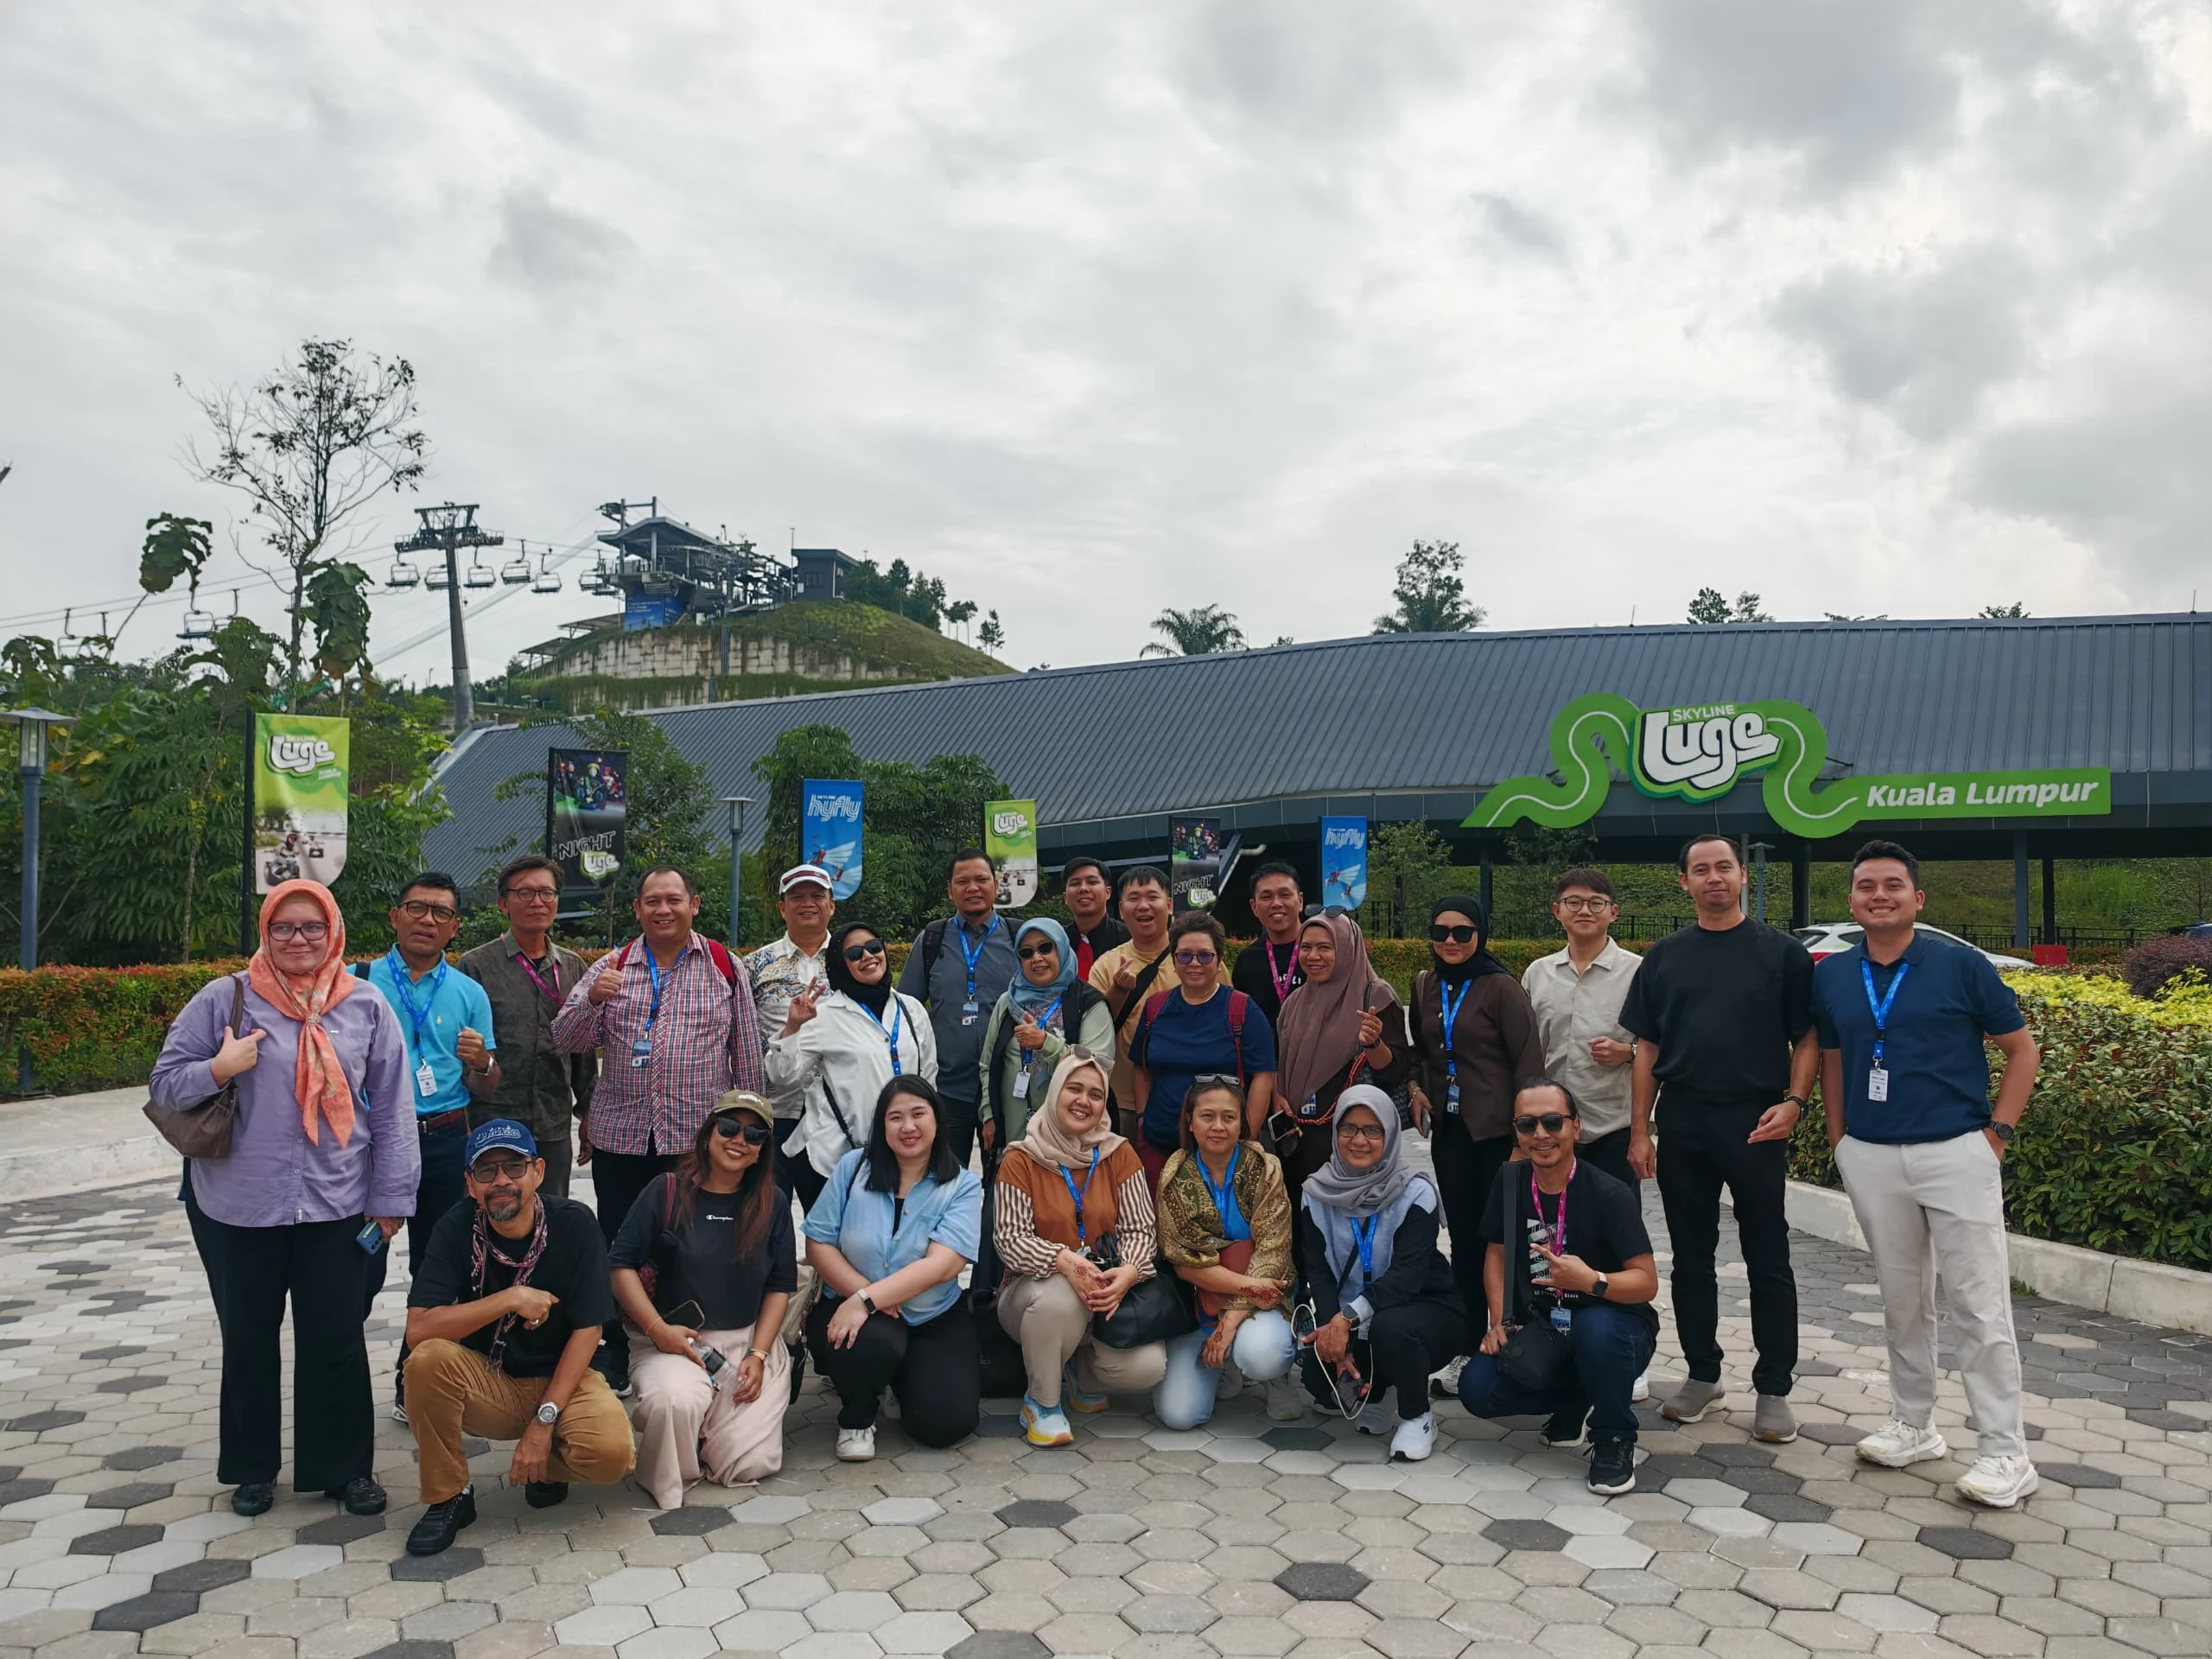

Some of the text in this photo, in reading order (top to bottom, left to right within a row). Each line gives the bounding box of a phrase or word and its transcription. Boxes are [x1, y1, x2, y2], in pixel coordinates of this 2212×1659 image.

[1672, 704, 1736, 721] SKYLINE
[1867, 782, 2099, 808] Kuala Lumpur
[559, 830, 616, 861] NIGHT
[1173, 874, 1214, 895] NIGHT
